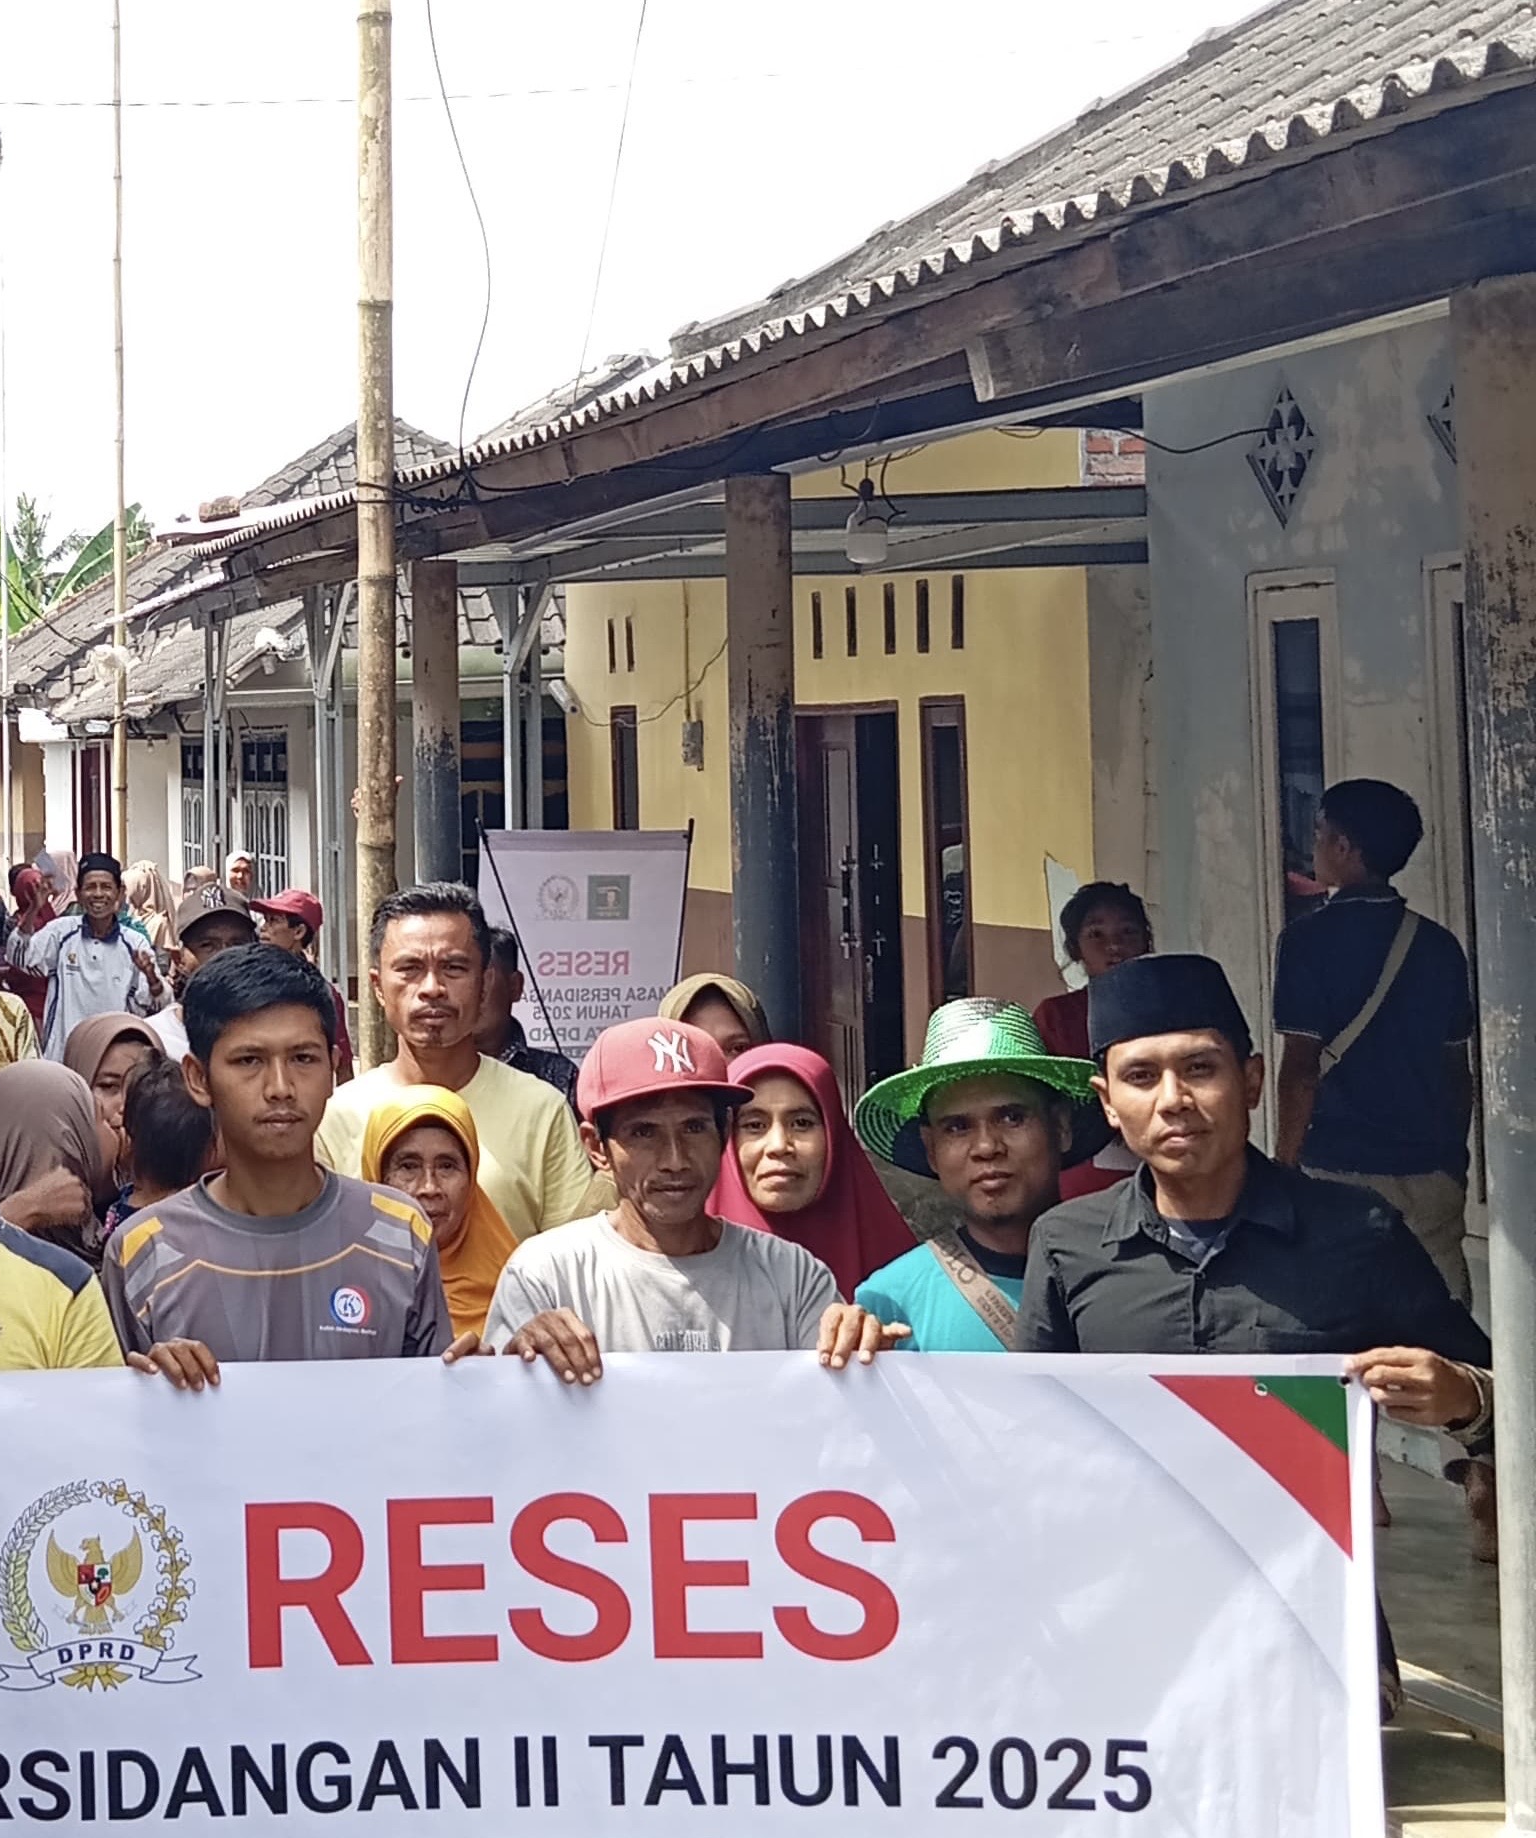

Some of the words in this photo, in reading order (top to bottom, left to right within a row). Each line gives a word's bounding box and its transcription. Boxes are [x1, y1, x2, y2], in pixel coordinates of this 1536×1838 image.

[647, 1031, 696, 1073] NY
[936, 1238, 978, 1284] OLO
[245, 1491, 901, 1669] RESES
[58, 1642, 135, 1664] DPRD
[514, 1735, 559, 1808] II
[588, 1734, 902, 1807] TAHUN
[932, 1736, 1152, 1813] 2025
